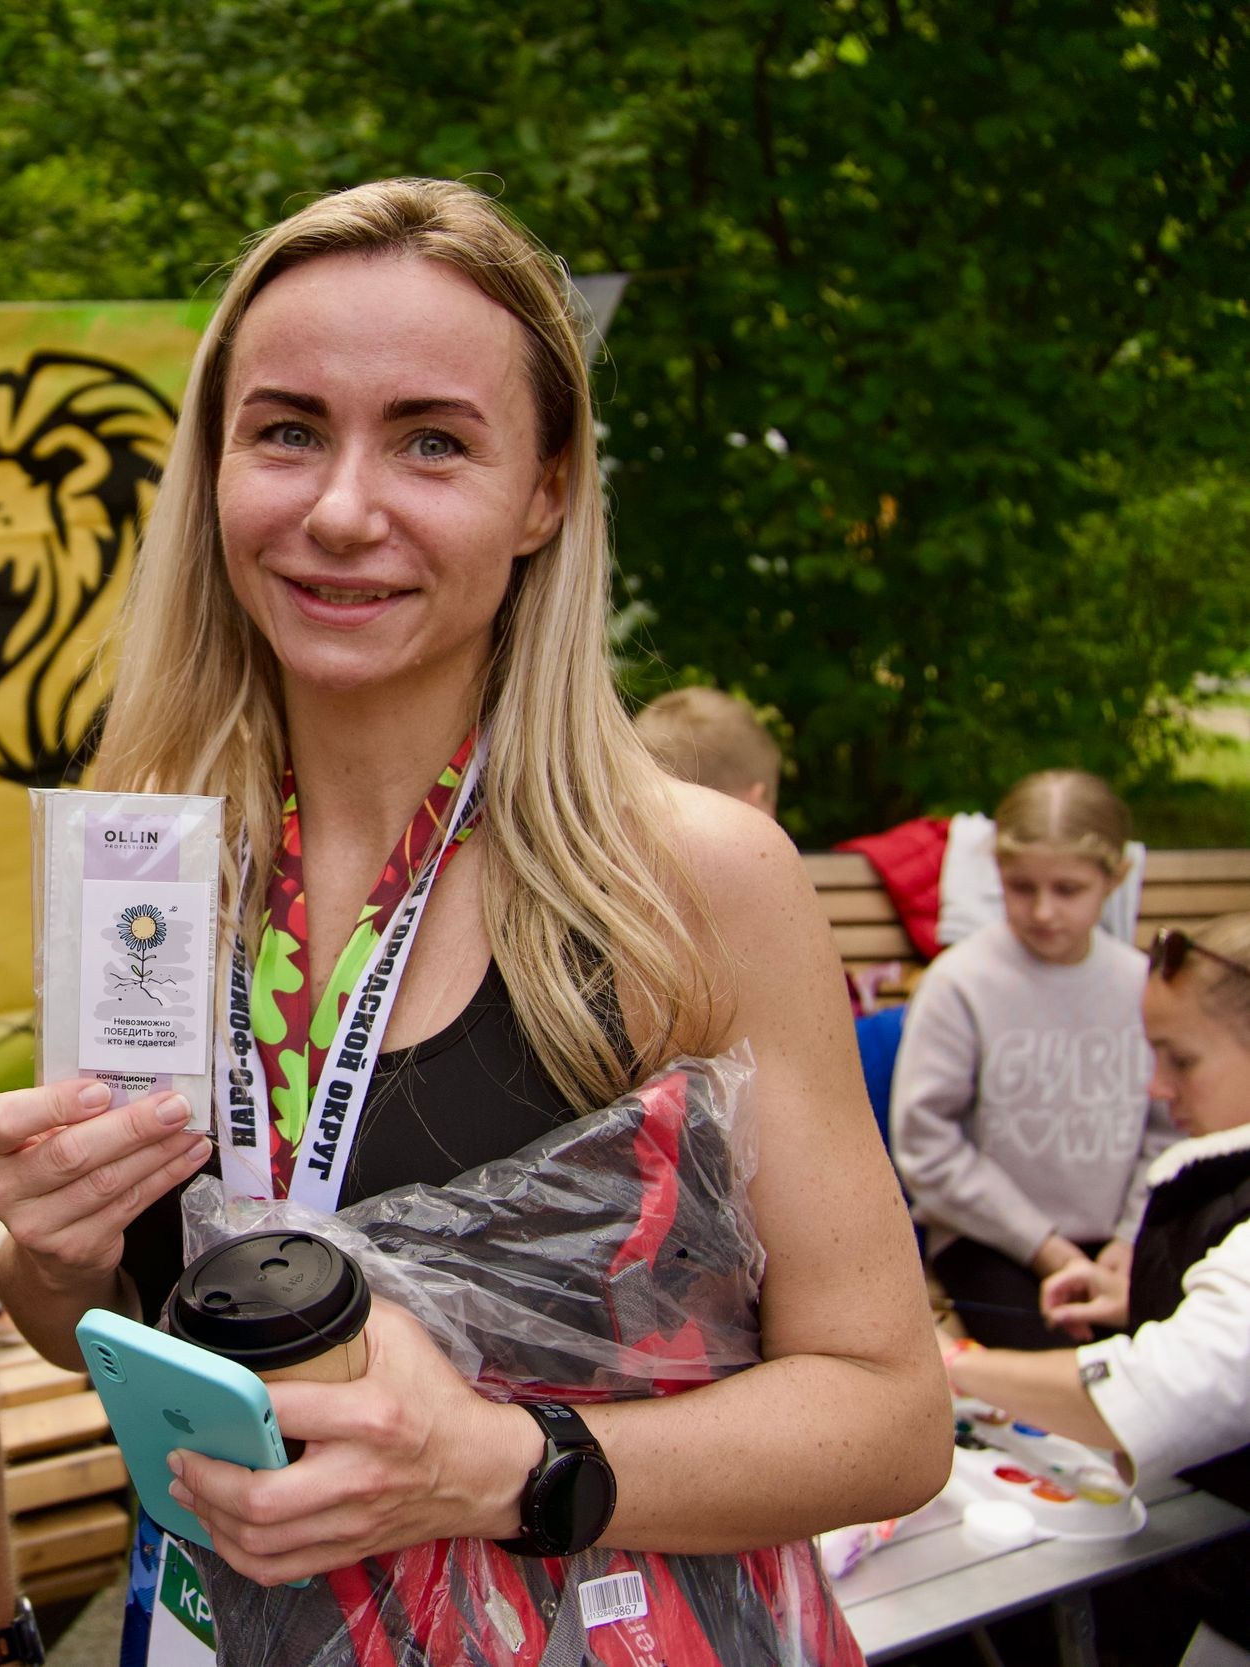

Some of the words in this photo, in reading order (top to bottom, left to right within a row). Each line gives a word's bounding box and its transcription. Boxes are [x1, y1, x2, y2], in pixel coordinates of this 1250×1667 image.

[104, 830, 158, 844] OLLIN
[336, 906, 418, 1073] ГОРОДСКОЙ
[113, 1017, 171, 1027] Невозможно
[104, 1027, 153, 1037] ПОБЕДИТЬ
[156, 1030, 178, 1039] того,
[96, 1073, 157, 1084] кондиционер
[308, 1080, 353, 1182] ОКРУГ
